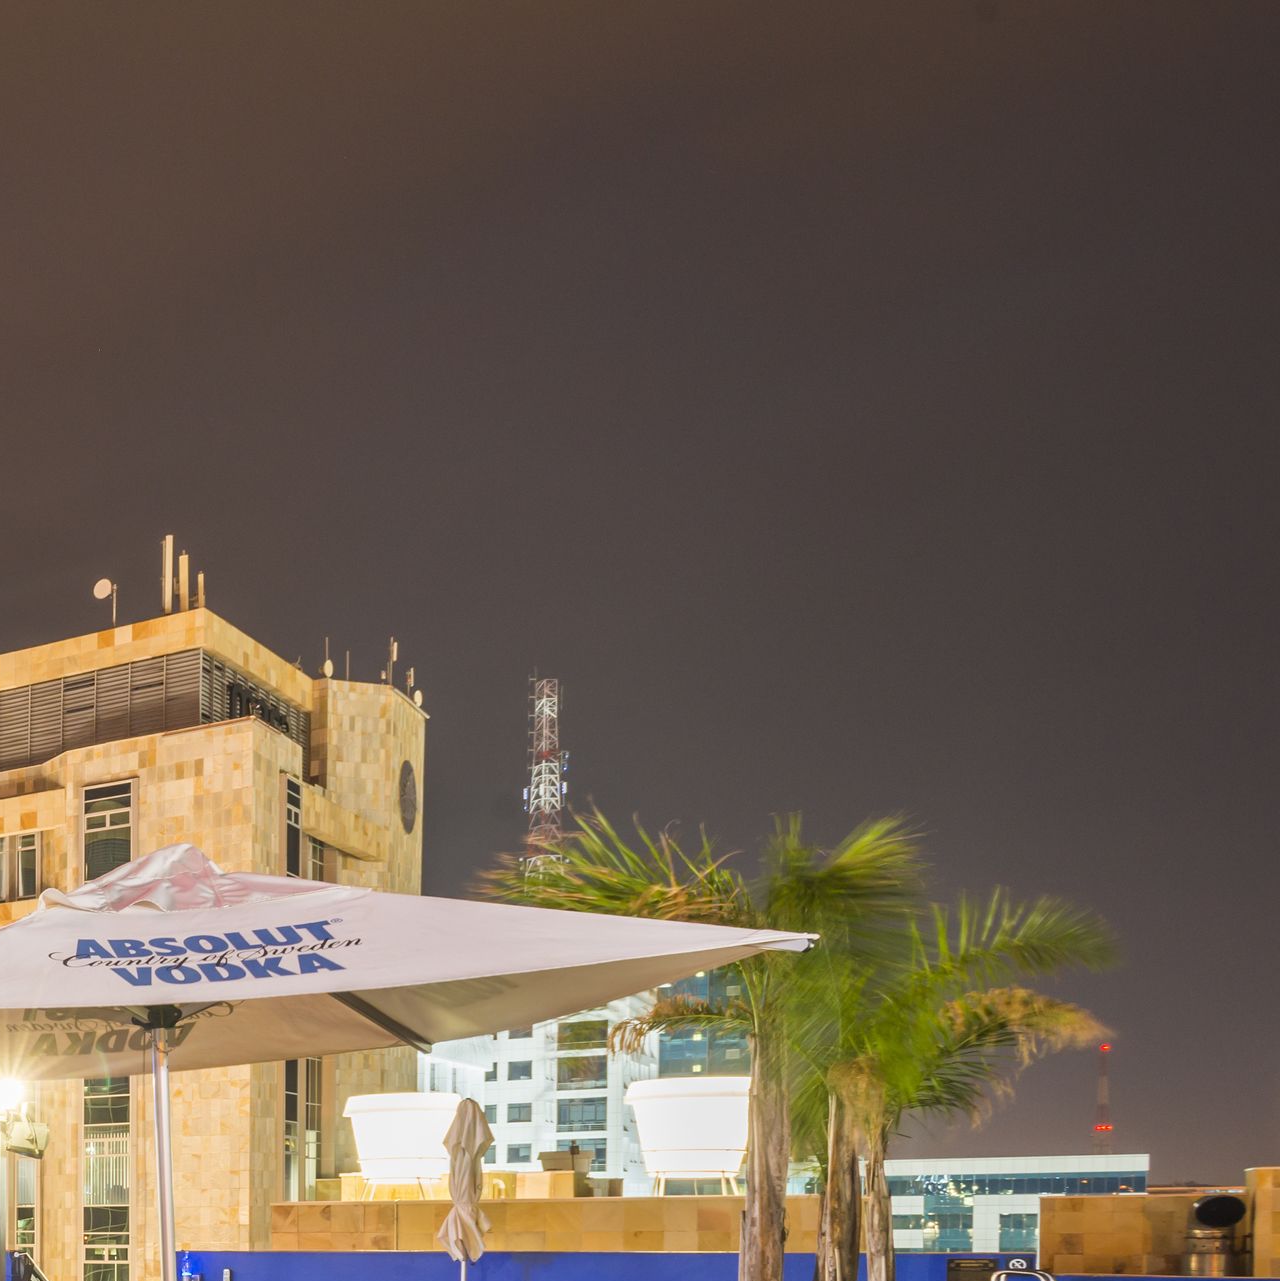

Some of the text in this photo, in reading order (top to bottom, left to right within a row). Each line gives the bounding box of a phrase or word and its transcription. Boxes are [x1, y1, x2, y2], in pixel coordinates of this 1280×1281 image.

[48, 936, 363, 970] Country of Sweden
[75, 919, 337, 959] ABSOLUT
[111, 953, 347, 987] VODKA
